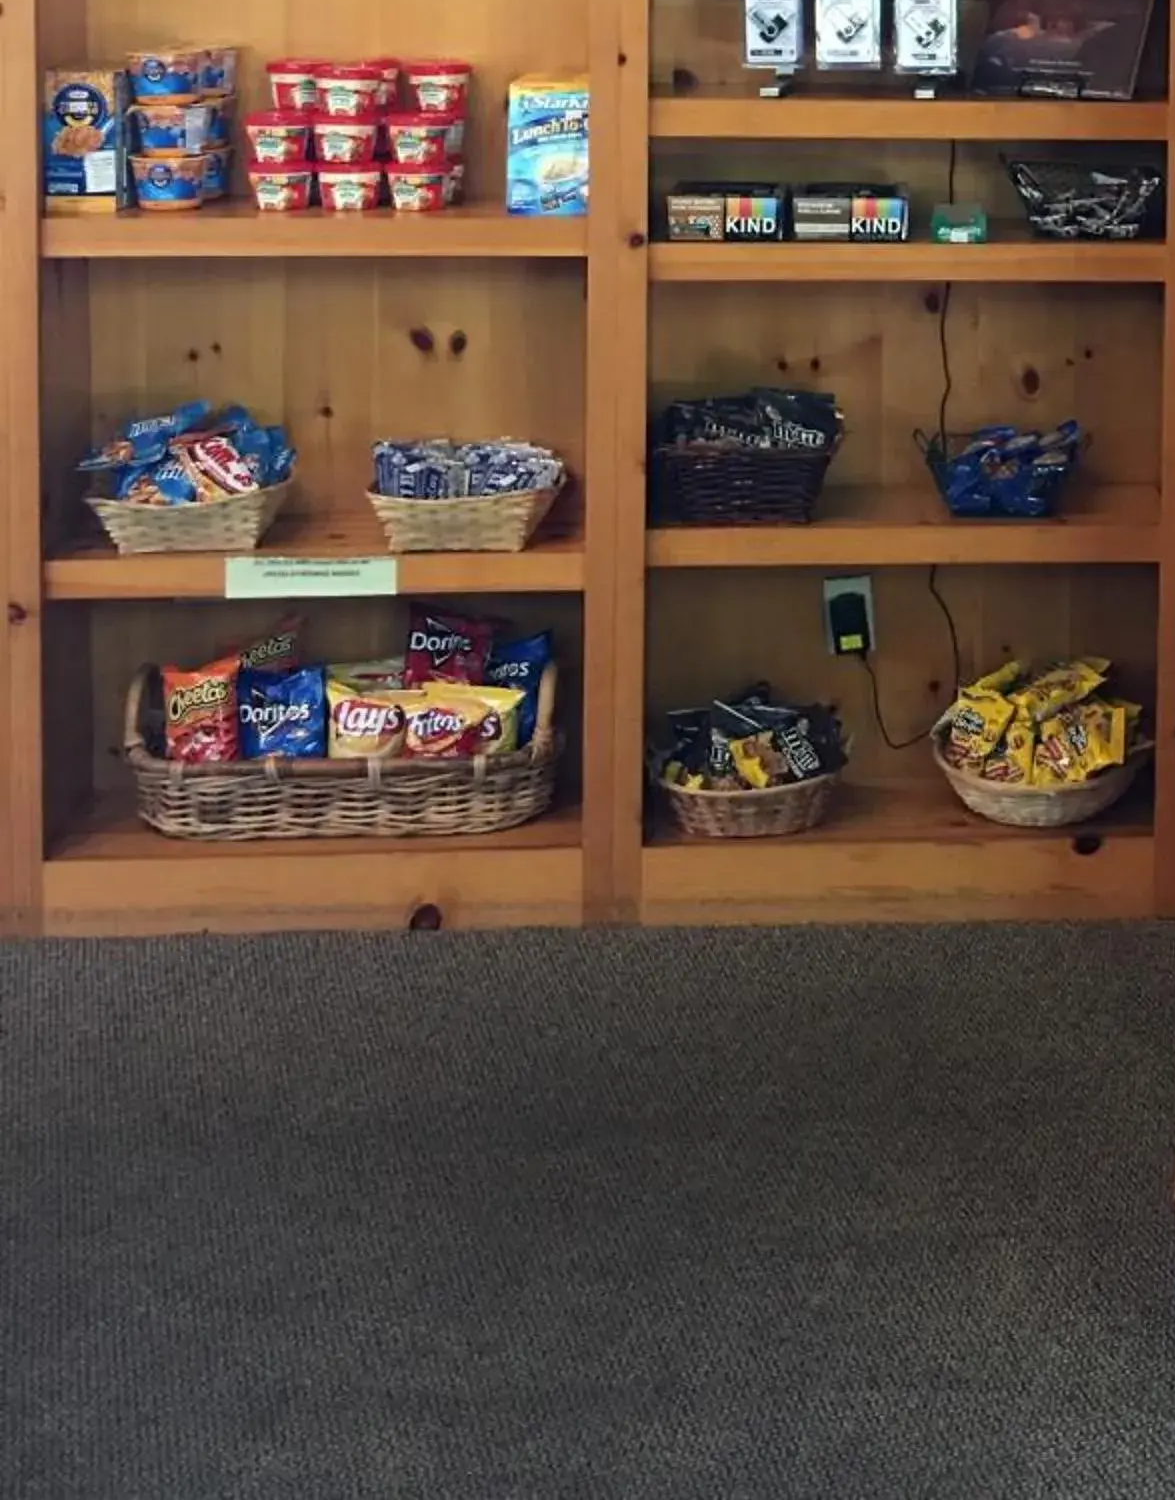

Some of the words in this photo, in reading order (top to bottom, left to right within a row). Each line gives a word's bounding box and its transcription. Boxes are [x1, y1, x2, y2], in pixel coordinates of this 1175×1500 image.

[725, 217, 776, 234] KIND
[851, 217, 901, 234] KIND
[168, 676, 229, 721] Cheetos
[239, 703, 310, 724] Doritos
[408, 706, 463, 738] Fritos
